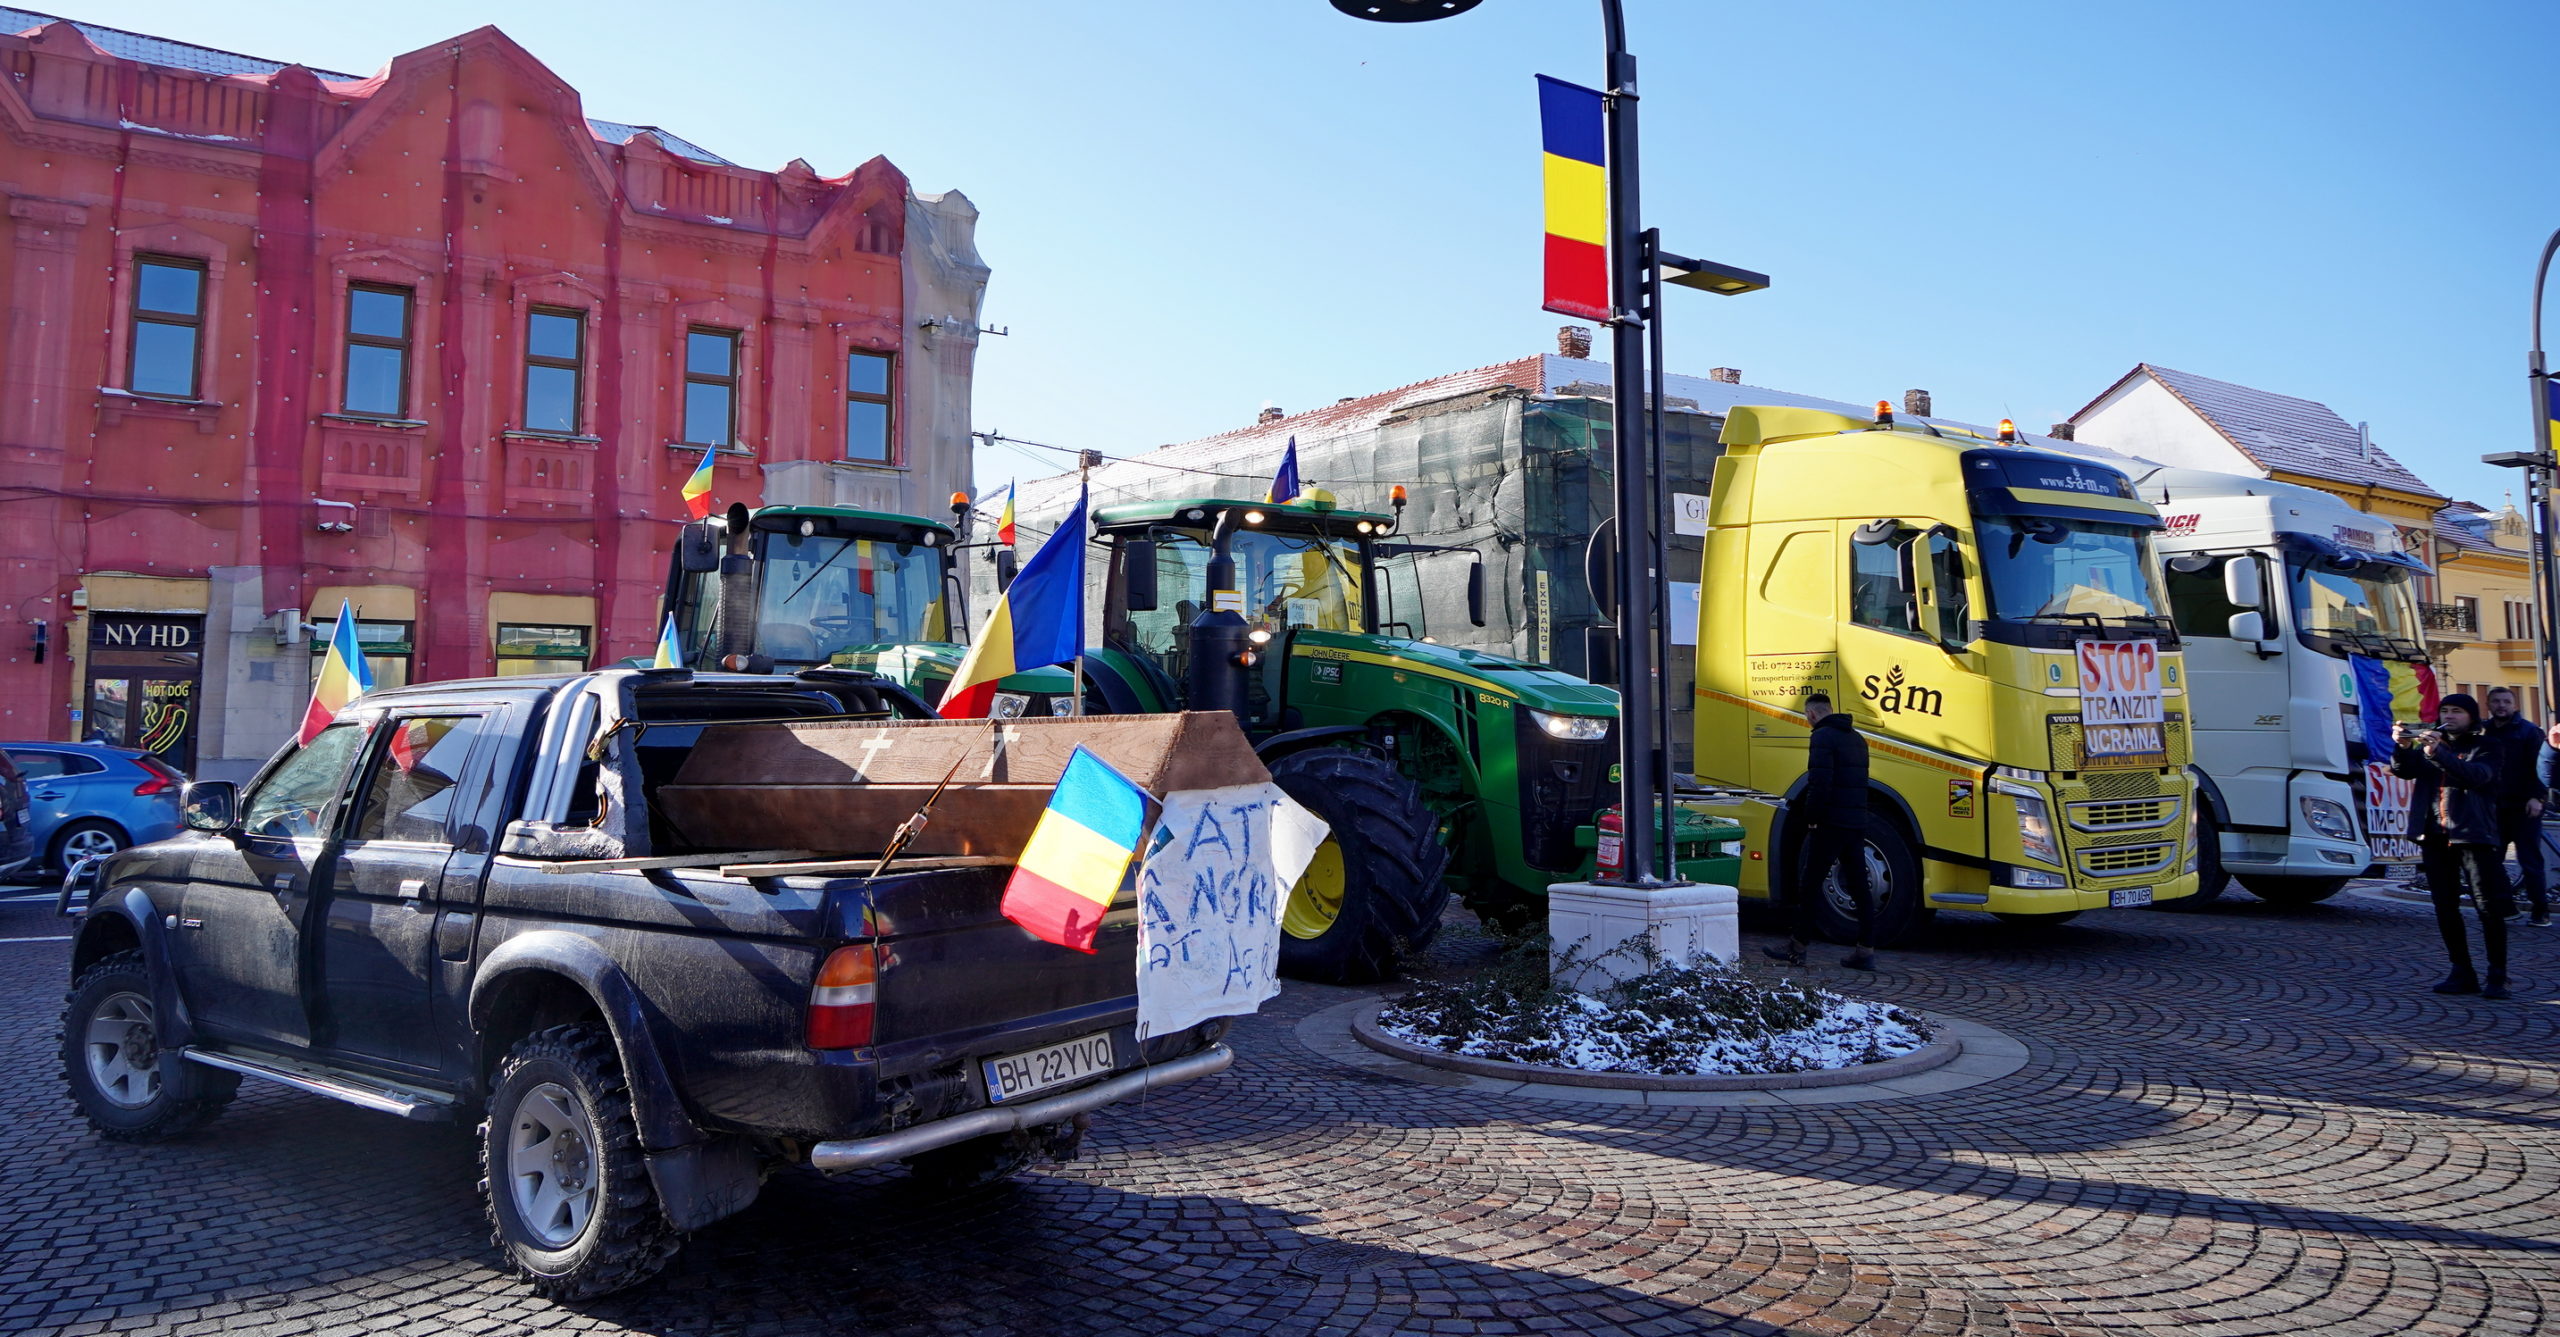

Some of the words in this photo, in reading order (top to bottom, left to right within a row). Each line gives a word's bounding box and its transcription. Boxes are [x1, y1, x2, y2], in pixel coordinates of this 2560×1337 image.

[1686, 498, 1709, 519] Gl
[1540, 582, 1549, 651] EXCHANGE
[105, 623, 143, 645] NY
[150, 625, 190, 647] HD
[1310, 648, 1328, 658] JOHN
[1329, 649, 1351, 660] DEERE
[1751, 662, 1768, 671] Tel:
[1794, 662, 1812, 671] 255
[2082, 643, 2155, 692] STOP
[146, 685, 165, 697] HOT
[167, 685, 189, 697] DOG
[1860, 674, 1943, 717] sam
[2084, 695, 2158, 720] TRANZIT
[2085, 727, 2162, 753] UCRAINA
[2367, 764, 2417, 808] STO
[2369, 808, 2410, 832] IMPO
[998, 1057, 1033, 1094] BH
